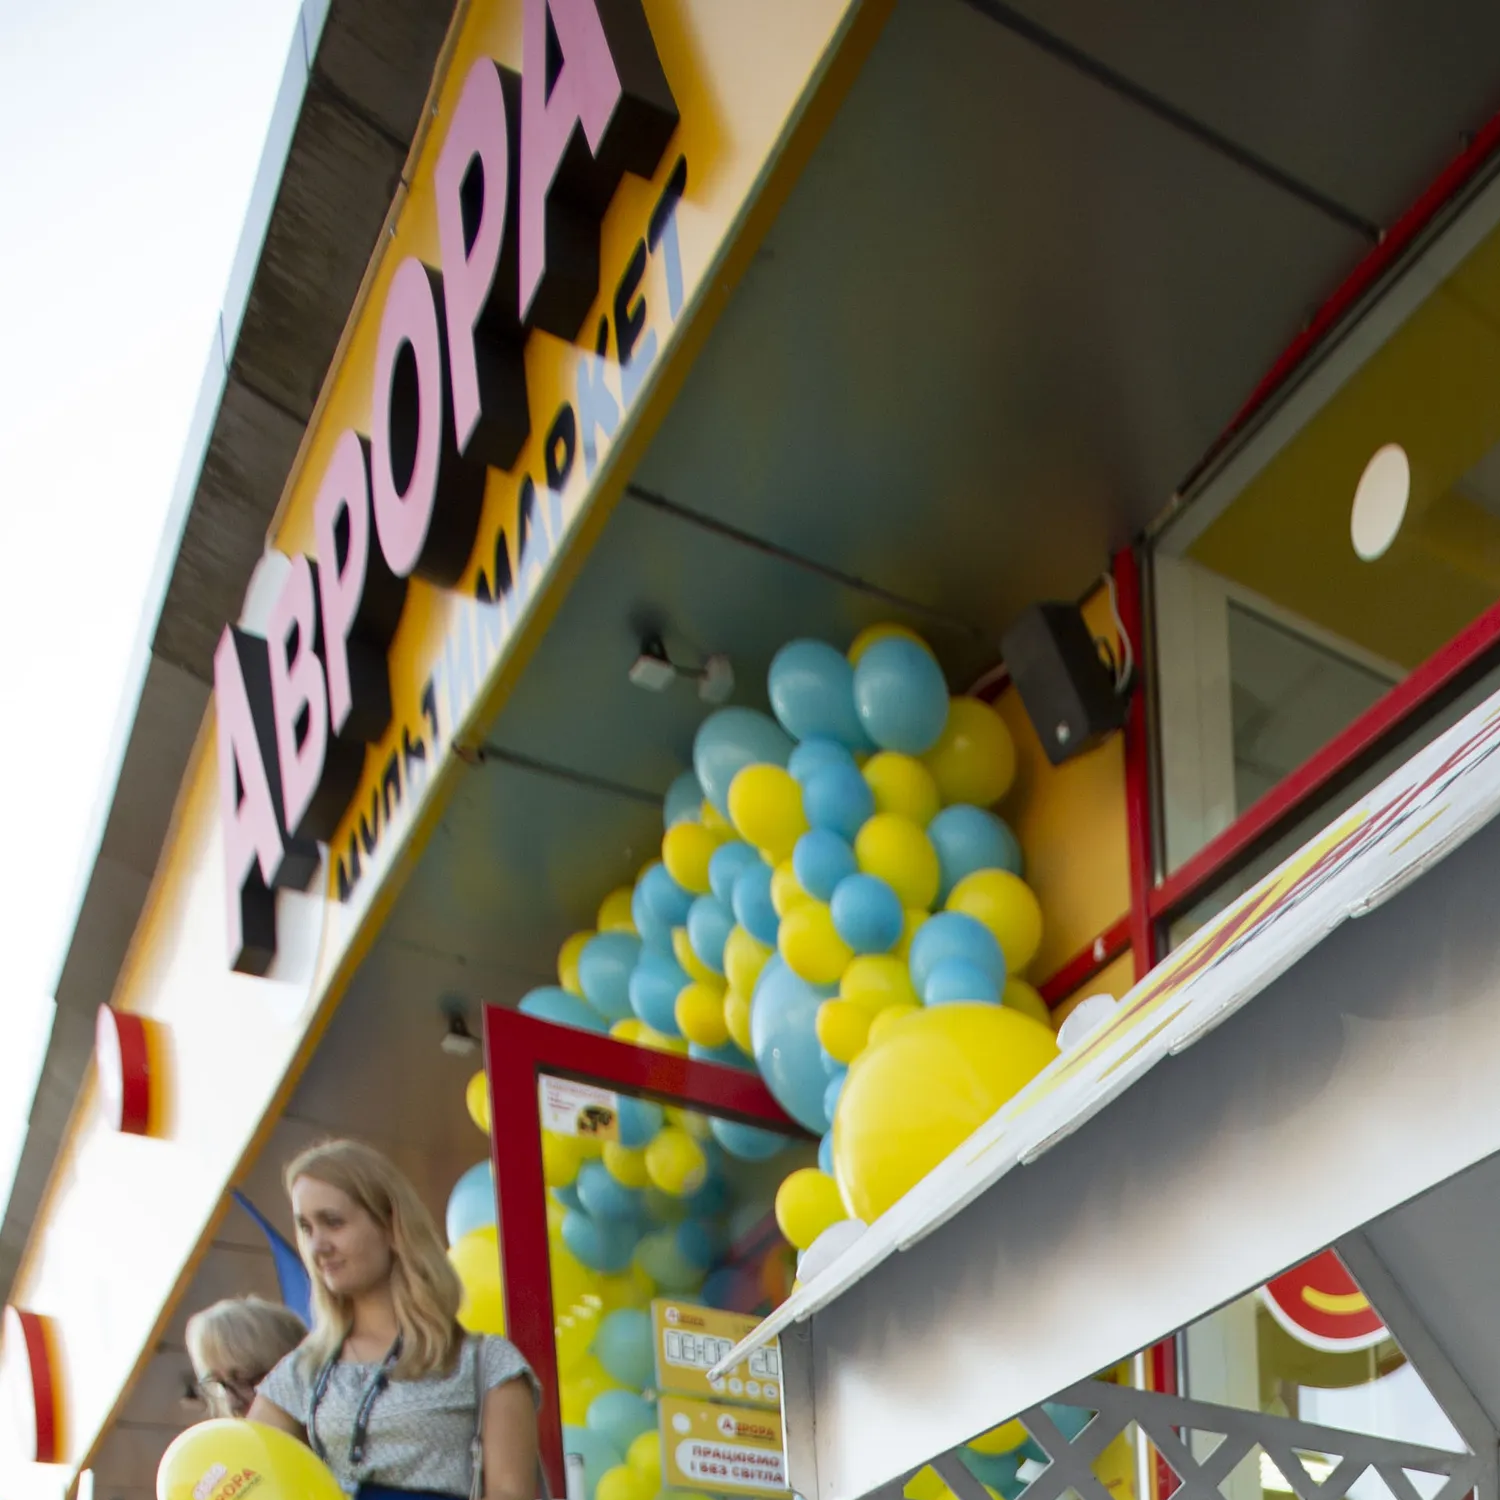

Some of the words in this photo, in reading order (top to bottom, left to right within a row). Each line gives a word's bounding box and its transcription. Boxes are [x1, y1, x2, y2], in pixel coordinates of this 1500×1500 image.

[213, 0, 624, 972] АВРОРА
[700, 1461, 728, 1476] БЕЗ
[731, 1466, 784, 1483] СВІТЛА
